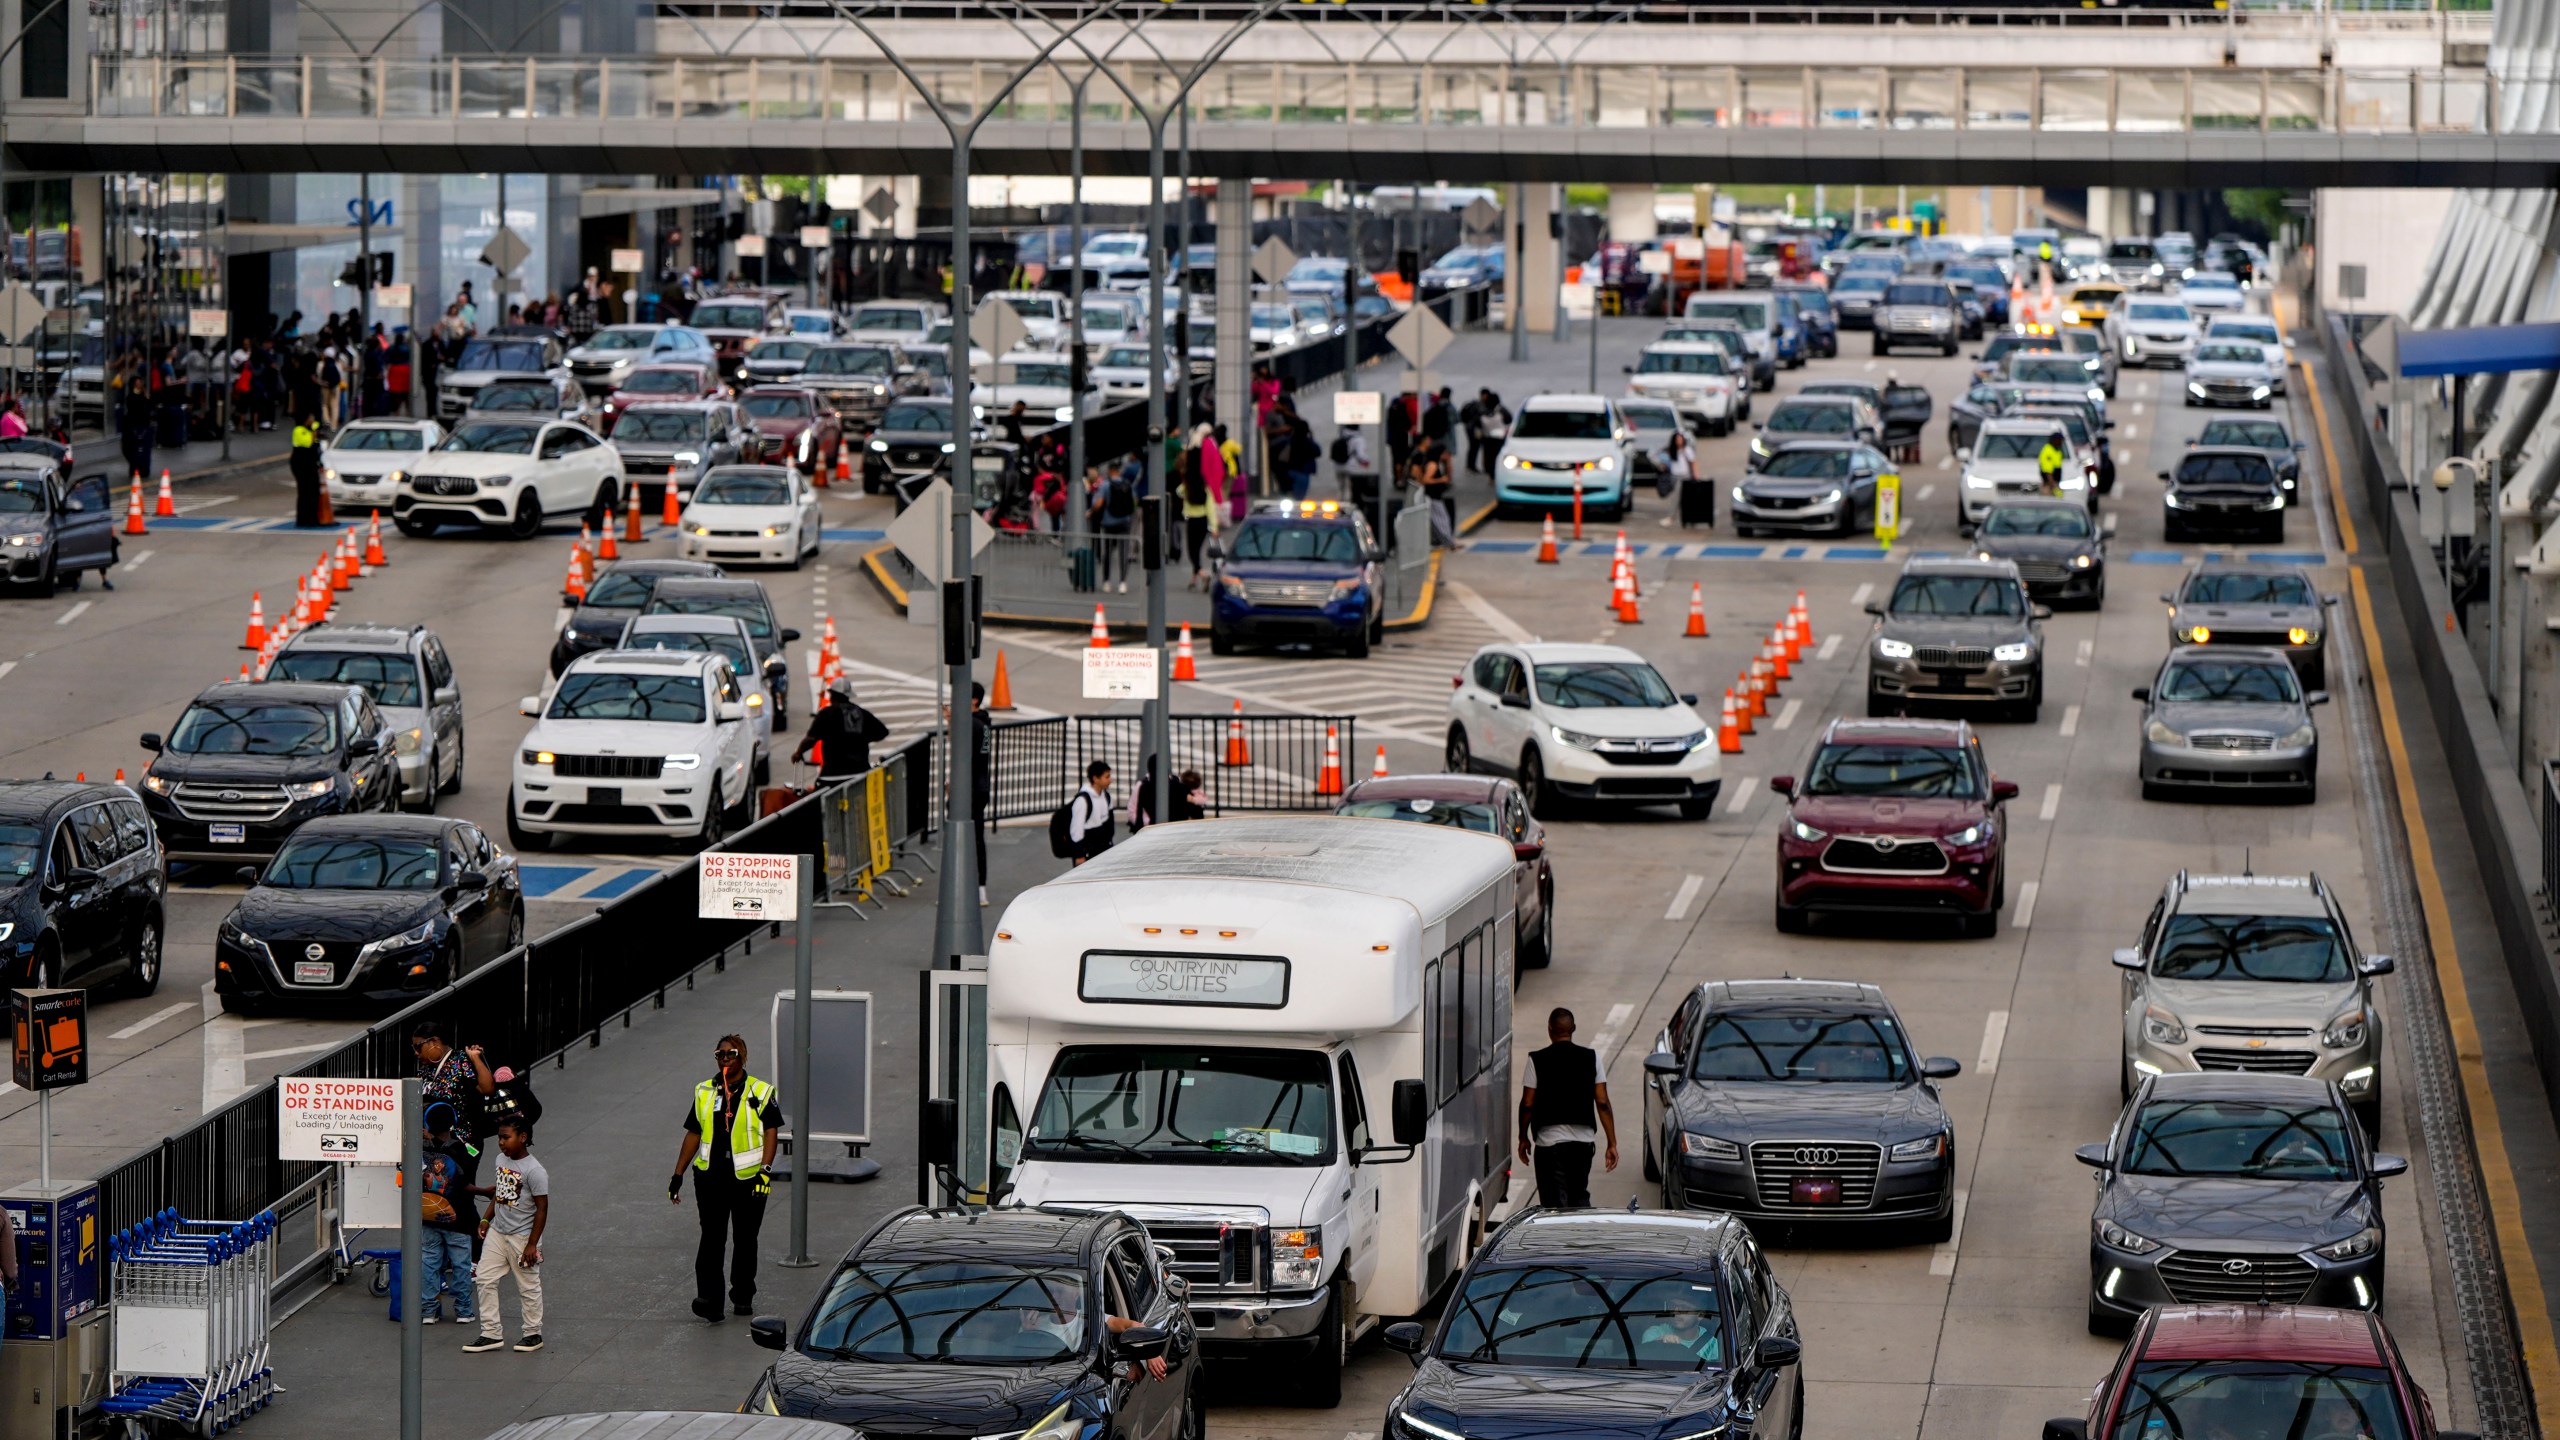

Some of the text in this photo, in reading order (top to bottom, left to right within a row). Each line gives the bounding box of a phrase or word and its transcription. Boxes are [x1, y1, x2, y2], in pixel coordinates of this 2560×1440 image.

[1105, 652, 1152, 660] STOPPING
[706, 857, 791, 868] NO STOPPING
[705, 868, 791, 879] OR STANDING
[1130, 959, 1238, 975] COUNTRY INN
[43, 1070, 77, 1082] Cart Rental
[286, 1083, 394, 1097] NO STOPPING
[285, 1097, 394, 1111] OR STANDING
[302, 1112, 377, 1121] Except for Active
[296, 1121, 330, 1129] Loading
[340, 1122, 384, 1130] Unloading
